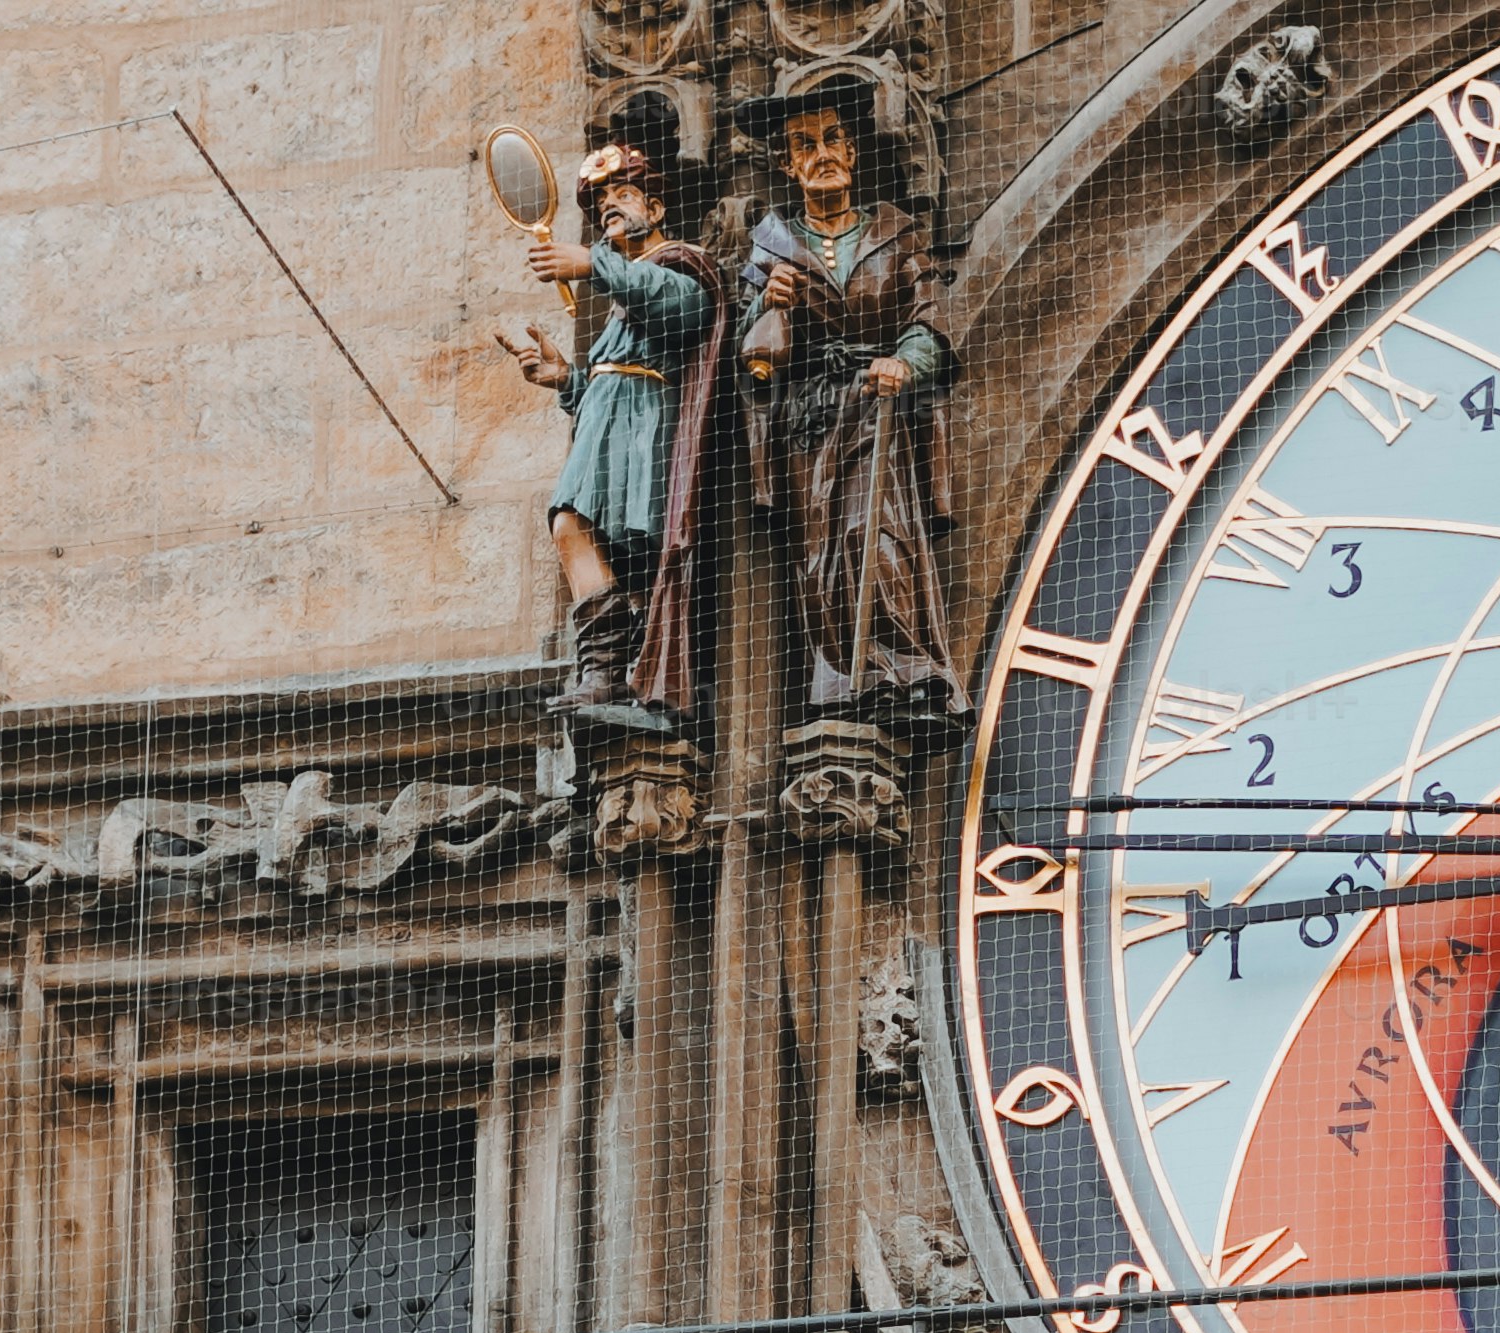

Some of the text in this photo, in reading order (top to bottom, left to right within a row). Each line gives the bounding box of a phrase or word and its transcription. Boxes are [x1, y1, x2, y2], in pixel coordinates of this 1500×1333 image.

[1328, 542, 1363, 598] 3
[1246, 734, 1276, 787] 2
[1328, 935, 1484, 1157] AVRORA
